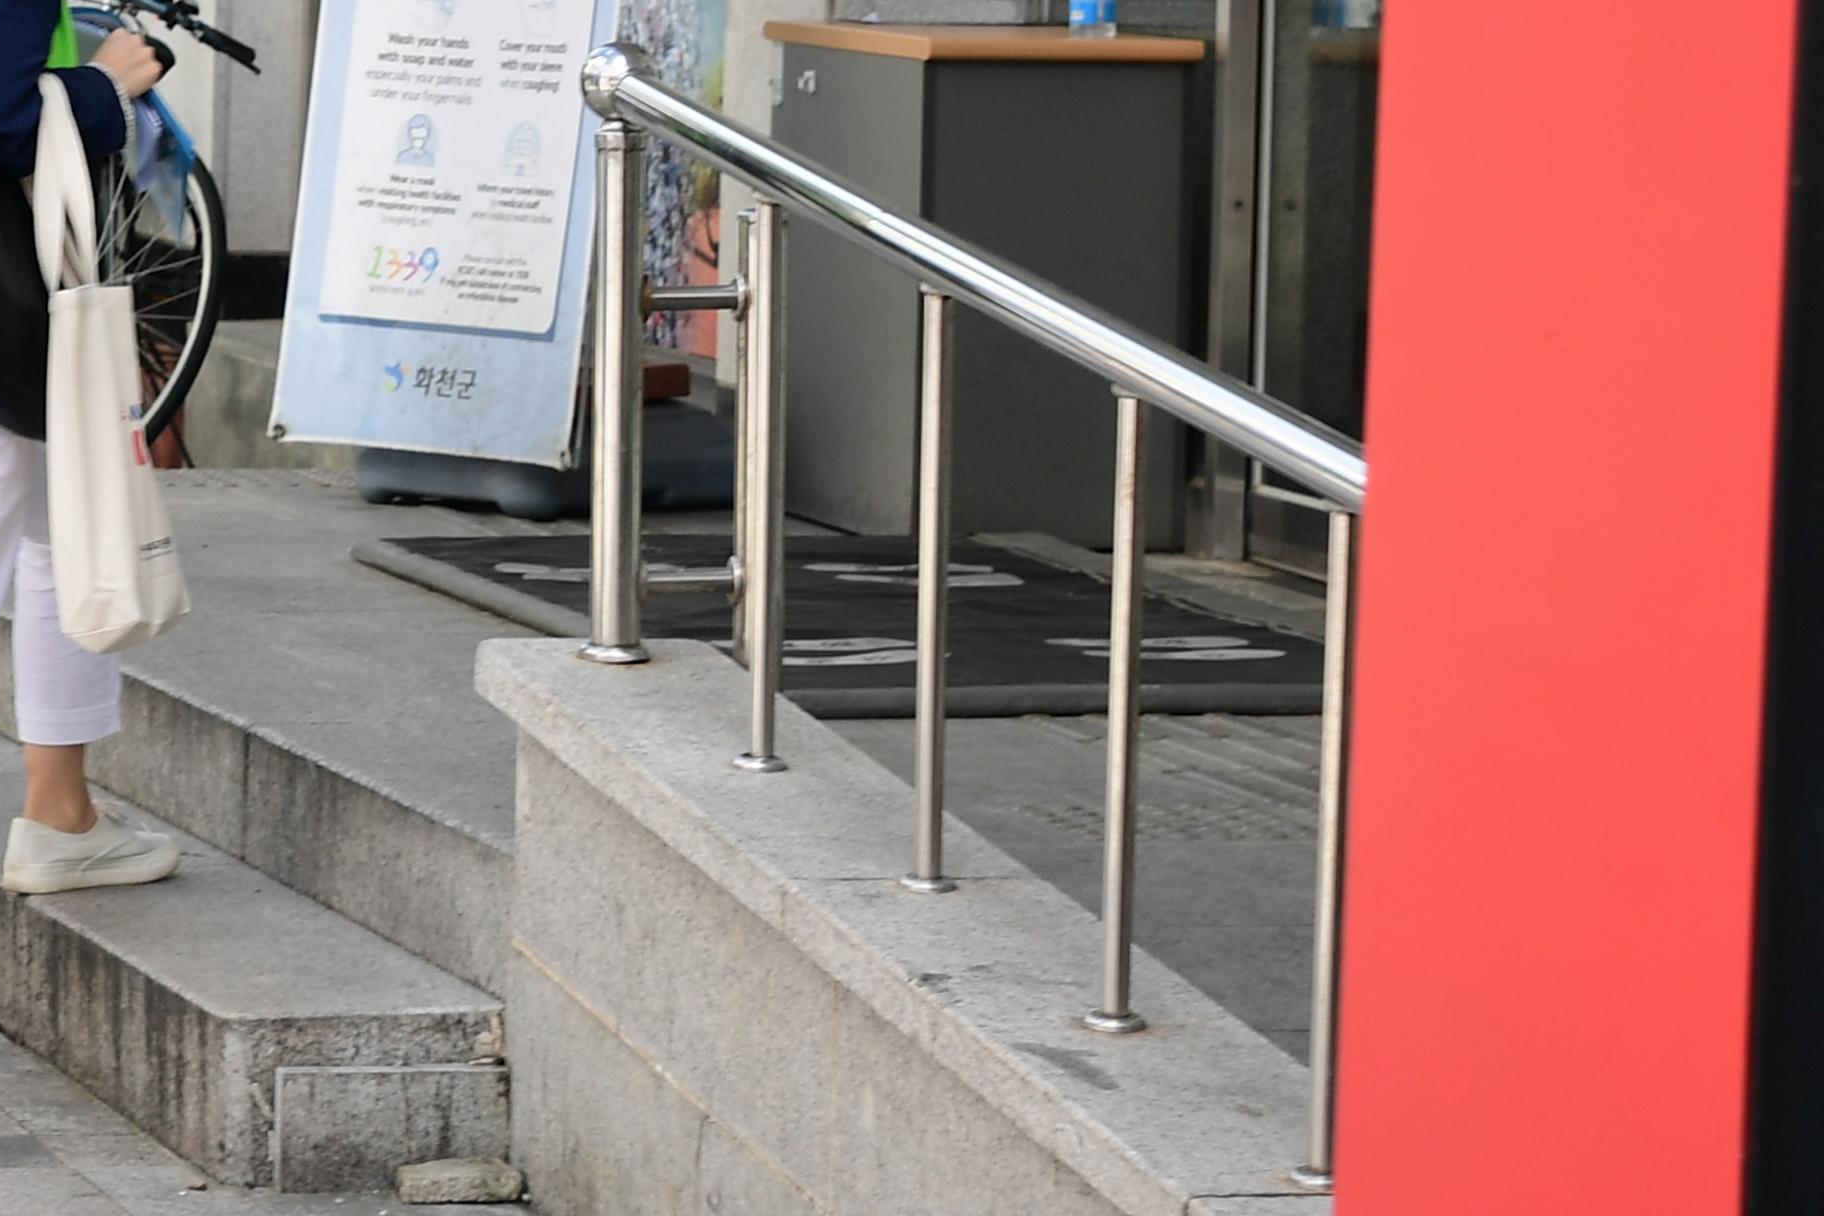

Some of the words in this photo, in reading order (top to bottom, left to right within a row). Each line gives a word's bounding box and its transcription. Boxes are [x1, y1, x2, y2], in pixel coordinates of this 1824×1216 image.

[418, 37, 438, 49] your
[499, 39, 523, 52] Cover
[428, 54, 445, 66] and
[367, 246, 439, 283] 1339
[413, 365, 477, 399] 화천군
